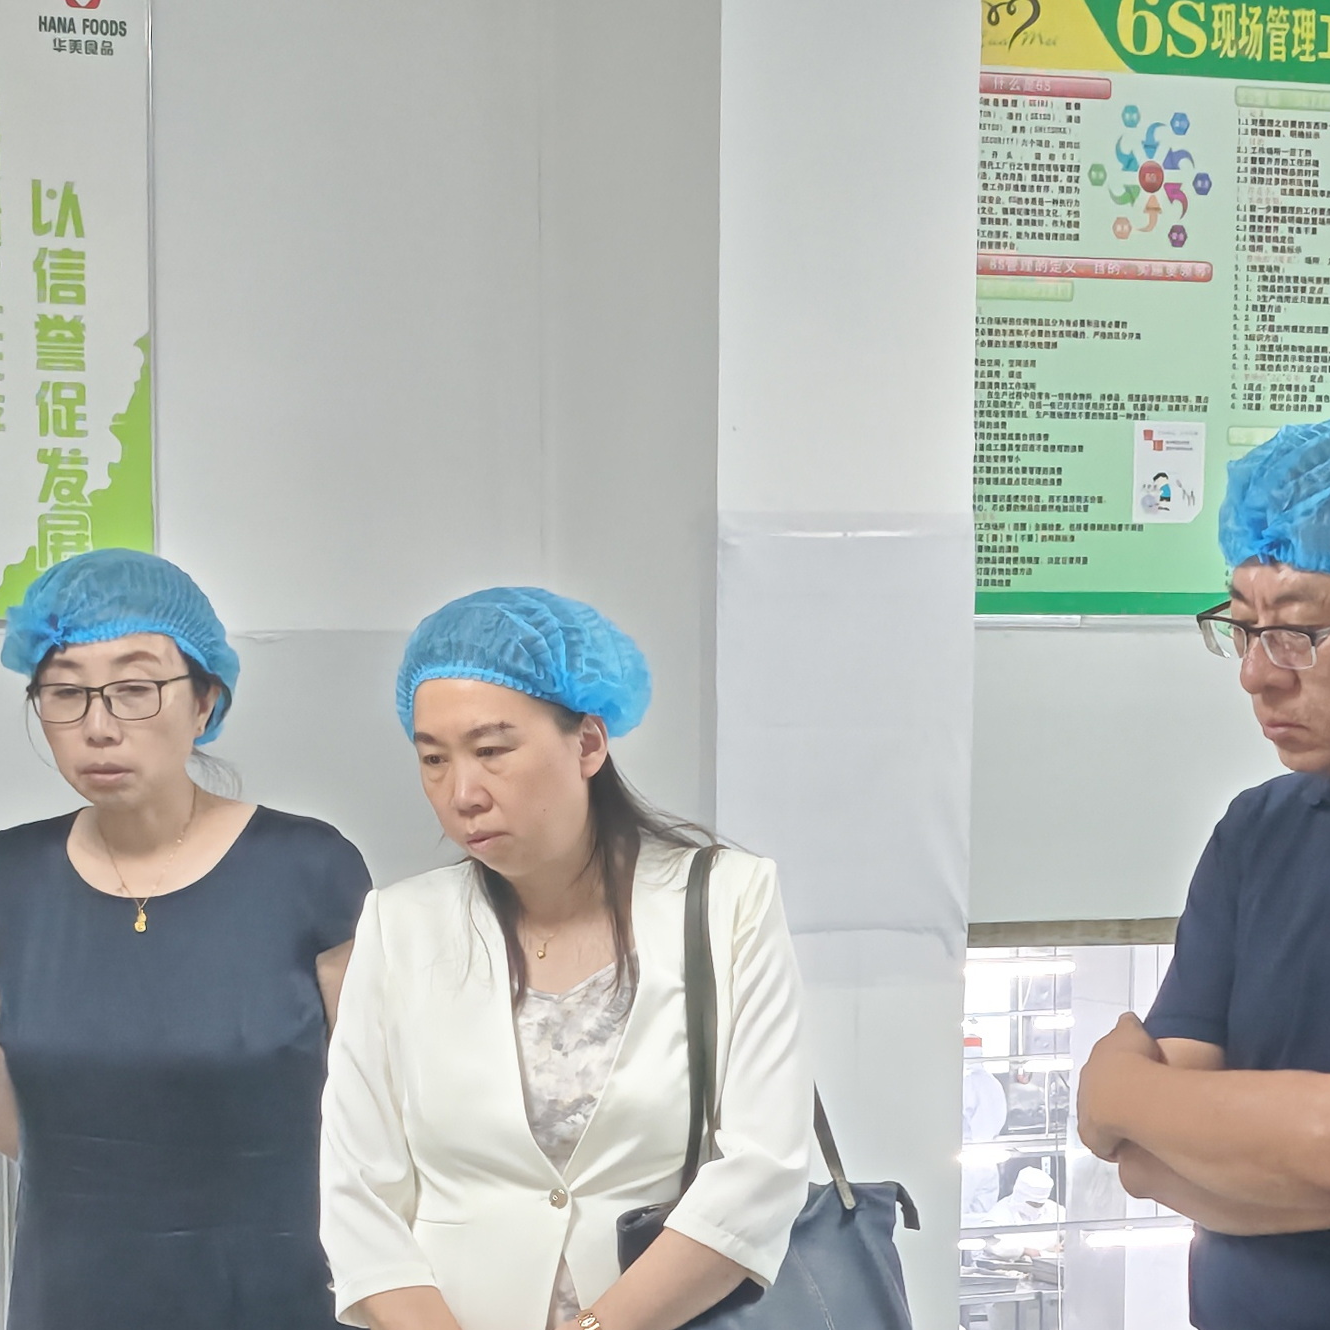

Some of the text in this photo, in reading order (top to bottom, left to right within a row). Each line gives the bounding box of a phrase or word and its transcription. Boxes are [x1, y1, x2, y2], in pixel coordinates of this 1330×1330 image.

[38, 15, 127, 37] HANA FOODS
[53, 37, 114, 56] 华美食品
[30, 178, 93, 571] 以信誉促发展
